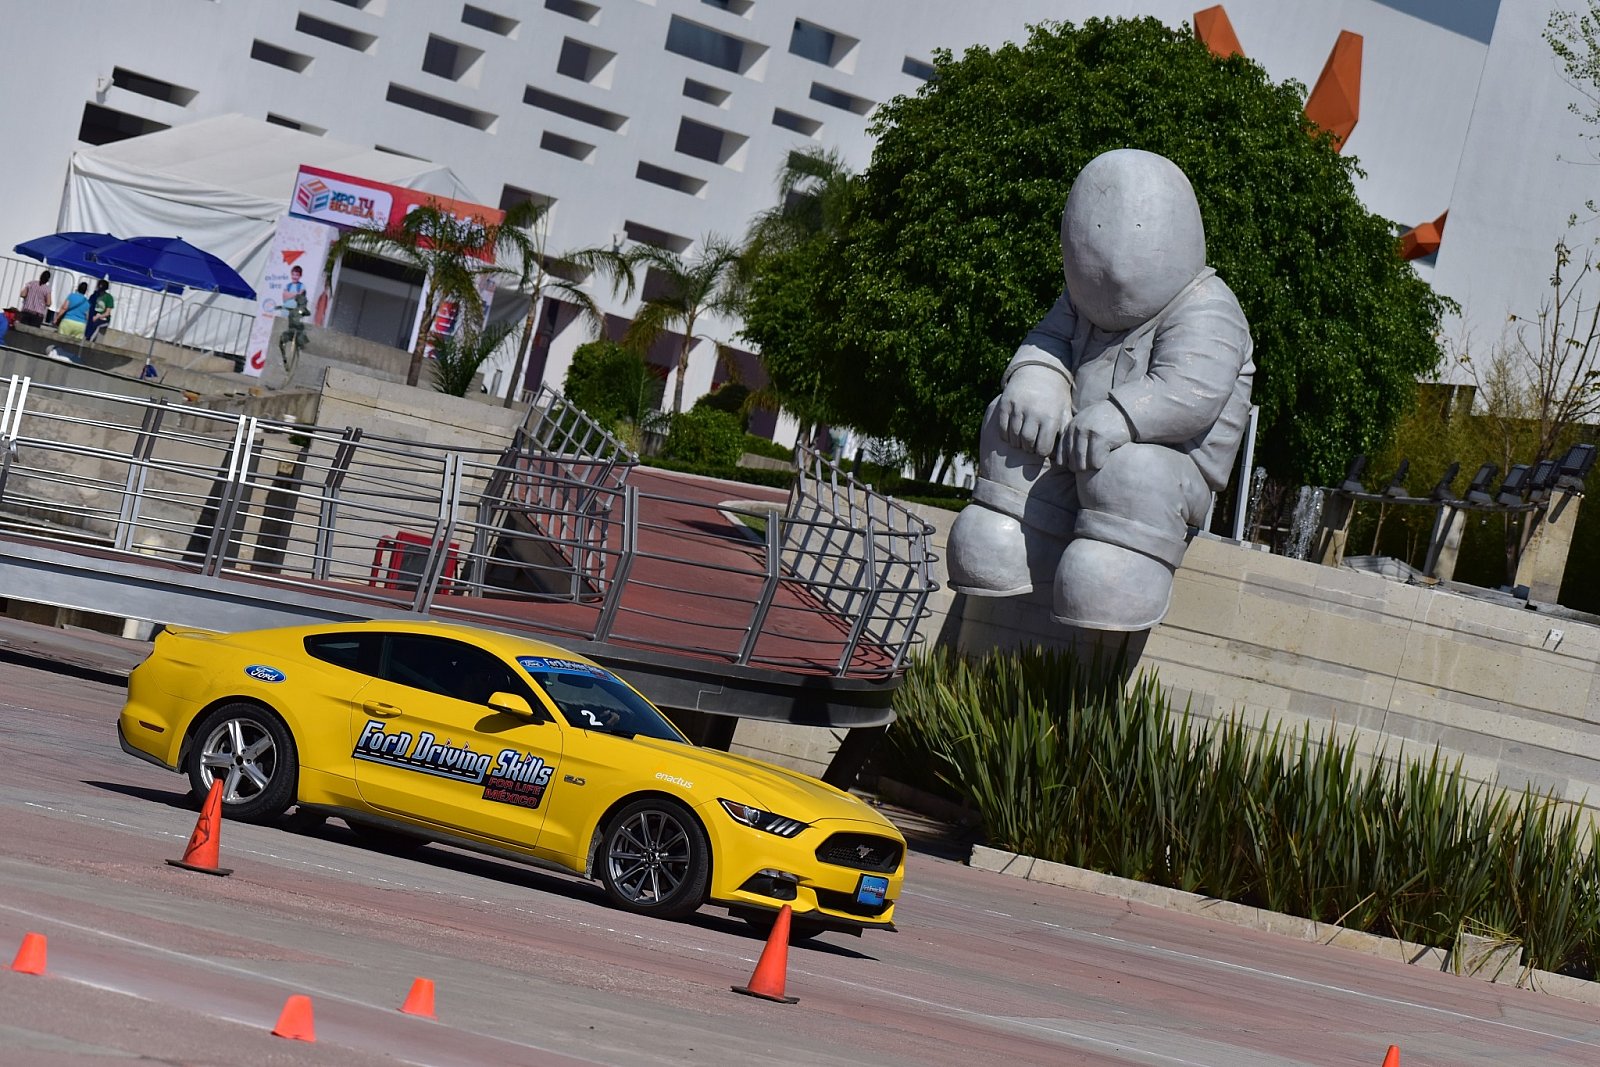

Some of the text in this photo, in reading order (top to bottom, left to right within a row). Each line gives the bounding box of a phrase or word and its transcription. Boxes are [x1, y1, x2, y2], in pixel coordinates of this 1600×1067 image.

[359, 197, 374, 210] TU
[251, 666, 279, 681] Ford
[580, 709, 604, 726] 2
[412, 731, 491, 784] Driving
[491, 750, 554, 786] Skills
[488, 777, 541, 796] FOR LIFE
[655, 772, 694, 789] enactus
